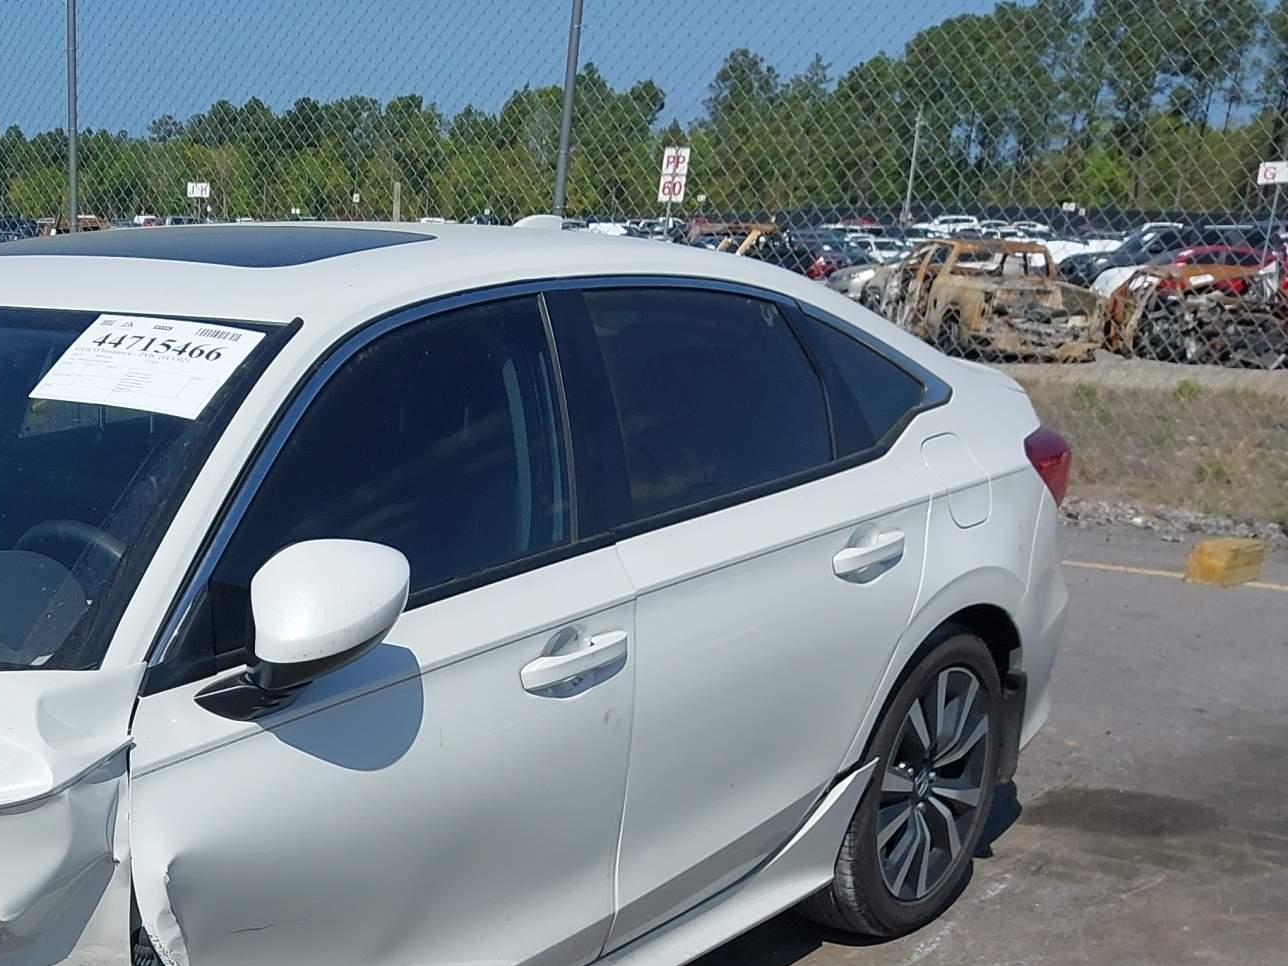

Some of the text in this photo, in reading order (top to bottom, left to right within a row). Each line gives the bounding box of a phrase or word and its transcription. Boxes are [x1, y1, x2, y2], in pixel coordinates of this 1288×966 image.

[666, 155, 687, 169] PP
[662, 181, 683, 196] 60
[92, 332, 230, 362] 44715466
